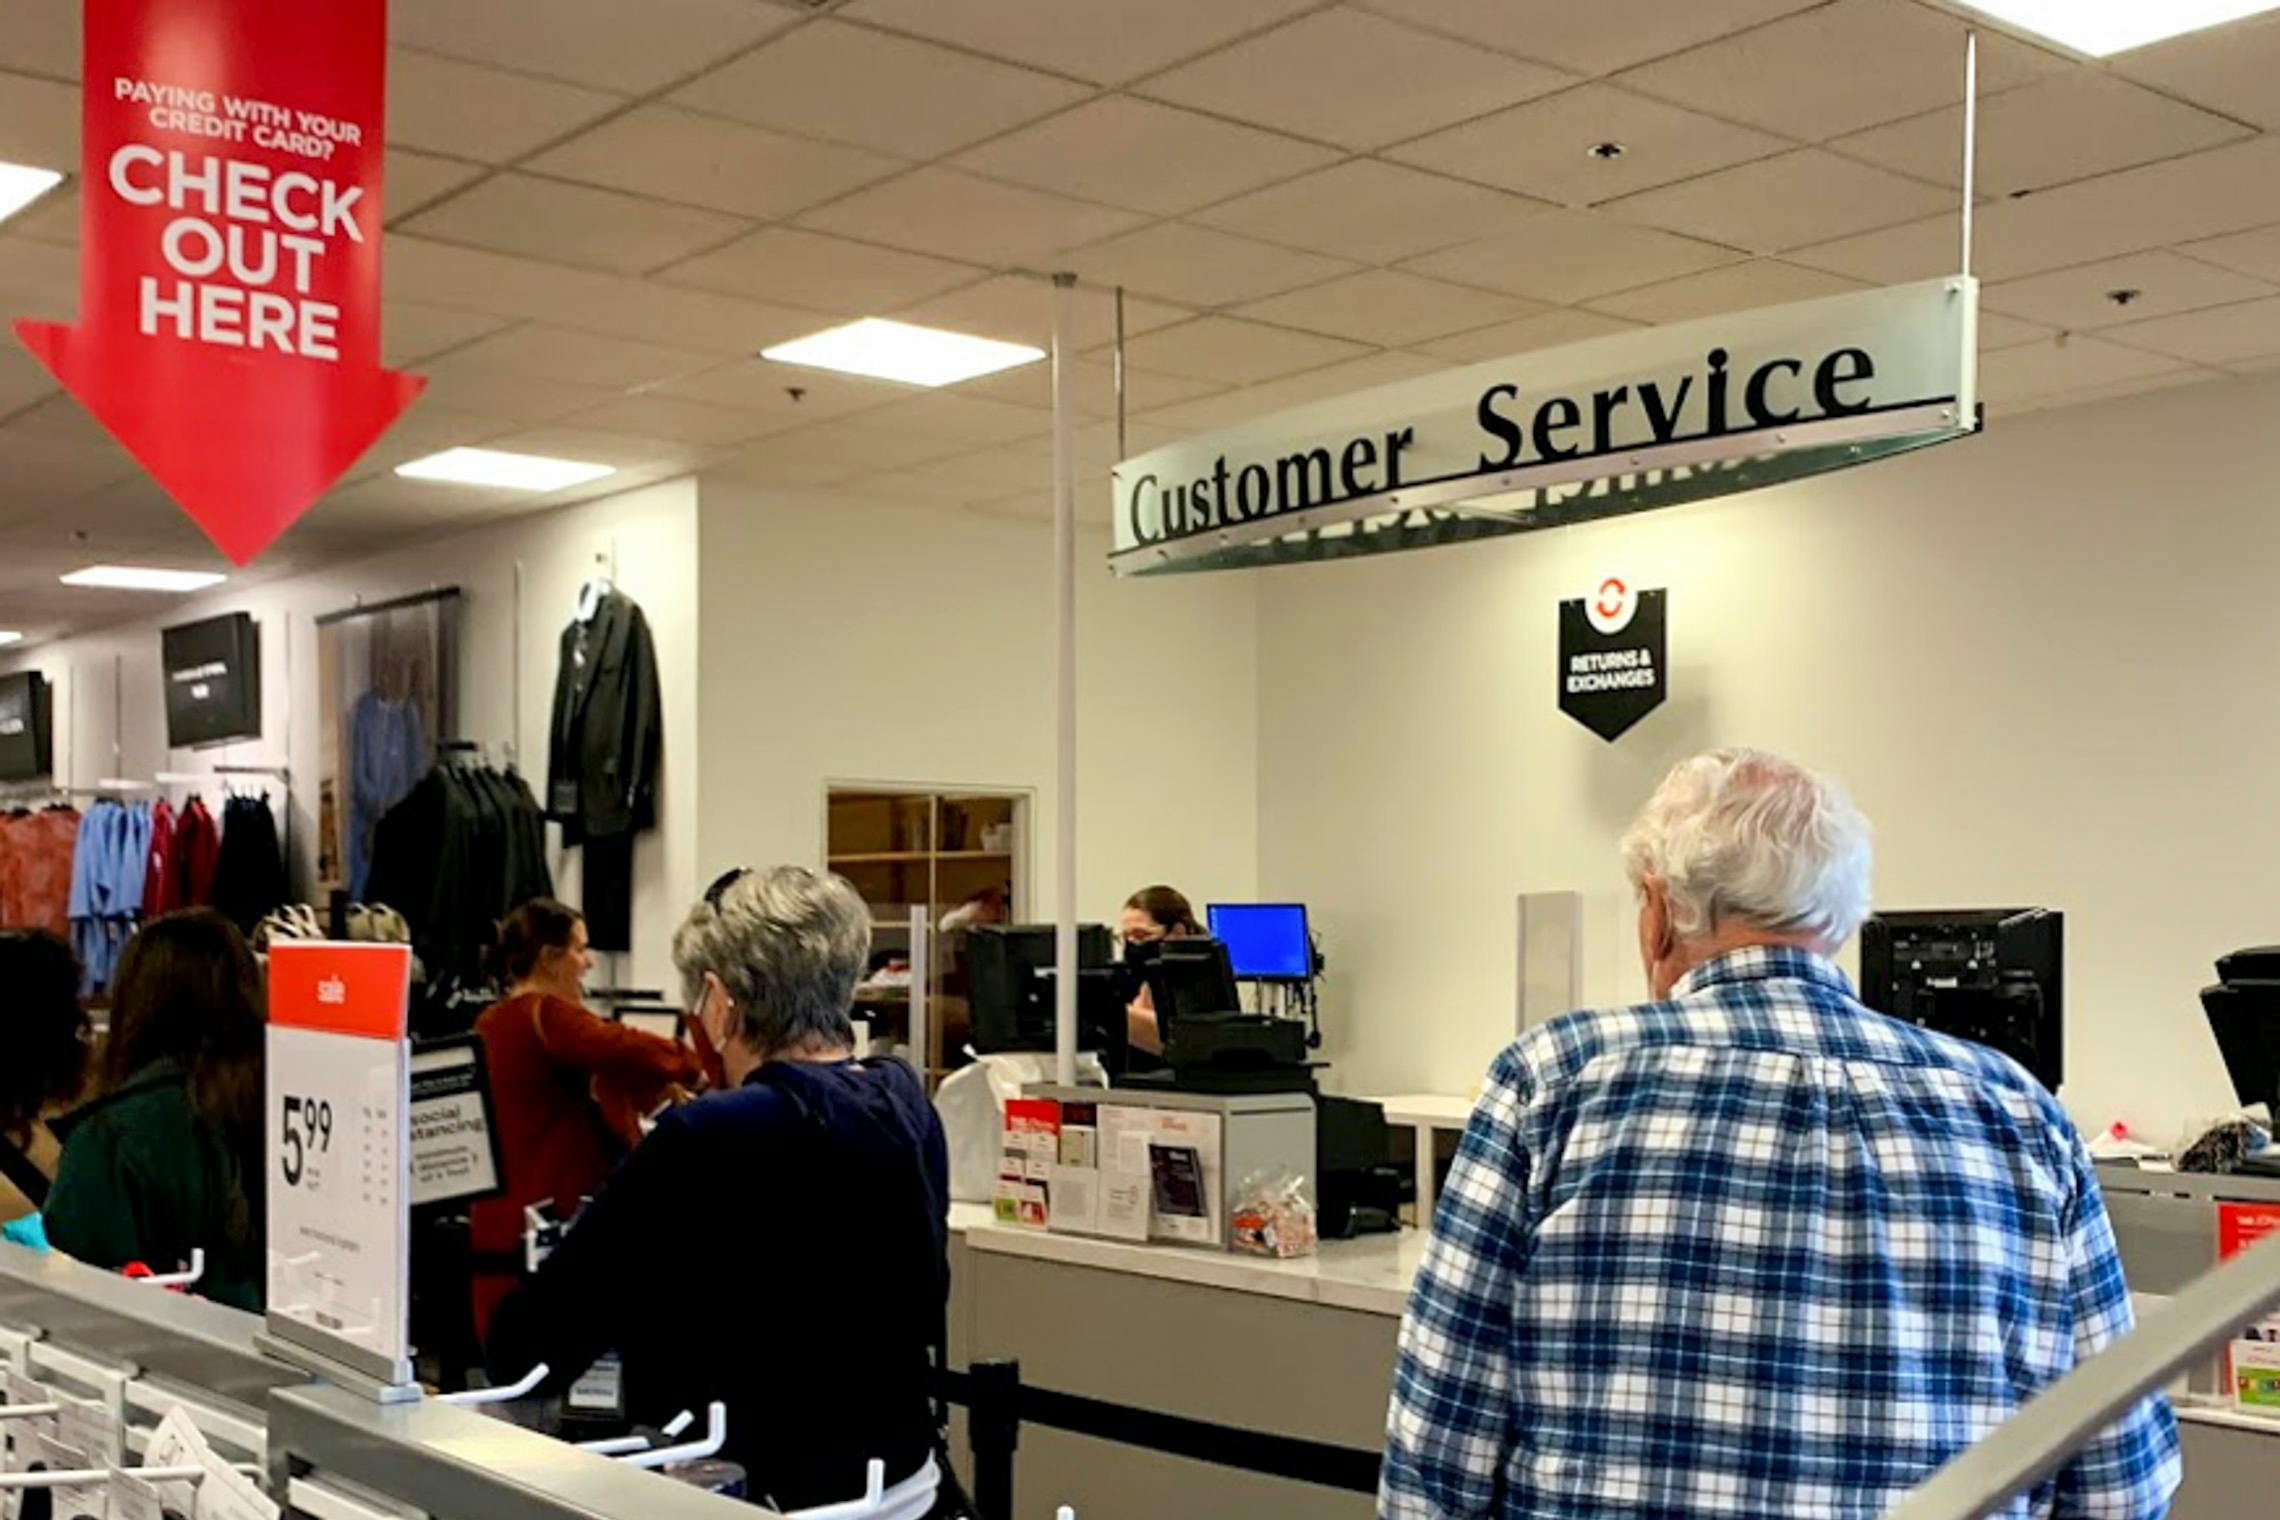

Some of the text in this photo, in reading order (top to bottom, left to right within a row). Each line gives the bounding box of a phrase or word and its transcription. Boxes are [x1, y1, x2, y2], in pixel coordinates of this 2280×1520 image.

[114, 77, 361, 146] PAYING WITH YOUR
[149, 107, 334, 161] CREDIT CARD?
[109, 143, 365, 243] CHECK
[162, 216, 325, 293] OUT
[140, 276, 339, 361] HERE
[1131, 426, 1414, 547] Customer
[1477, 347, 1875, 472] Service
[1571, 650, 1638, 672] RETURNS
